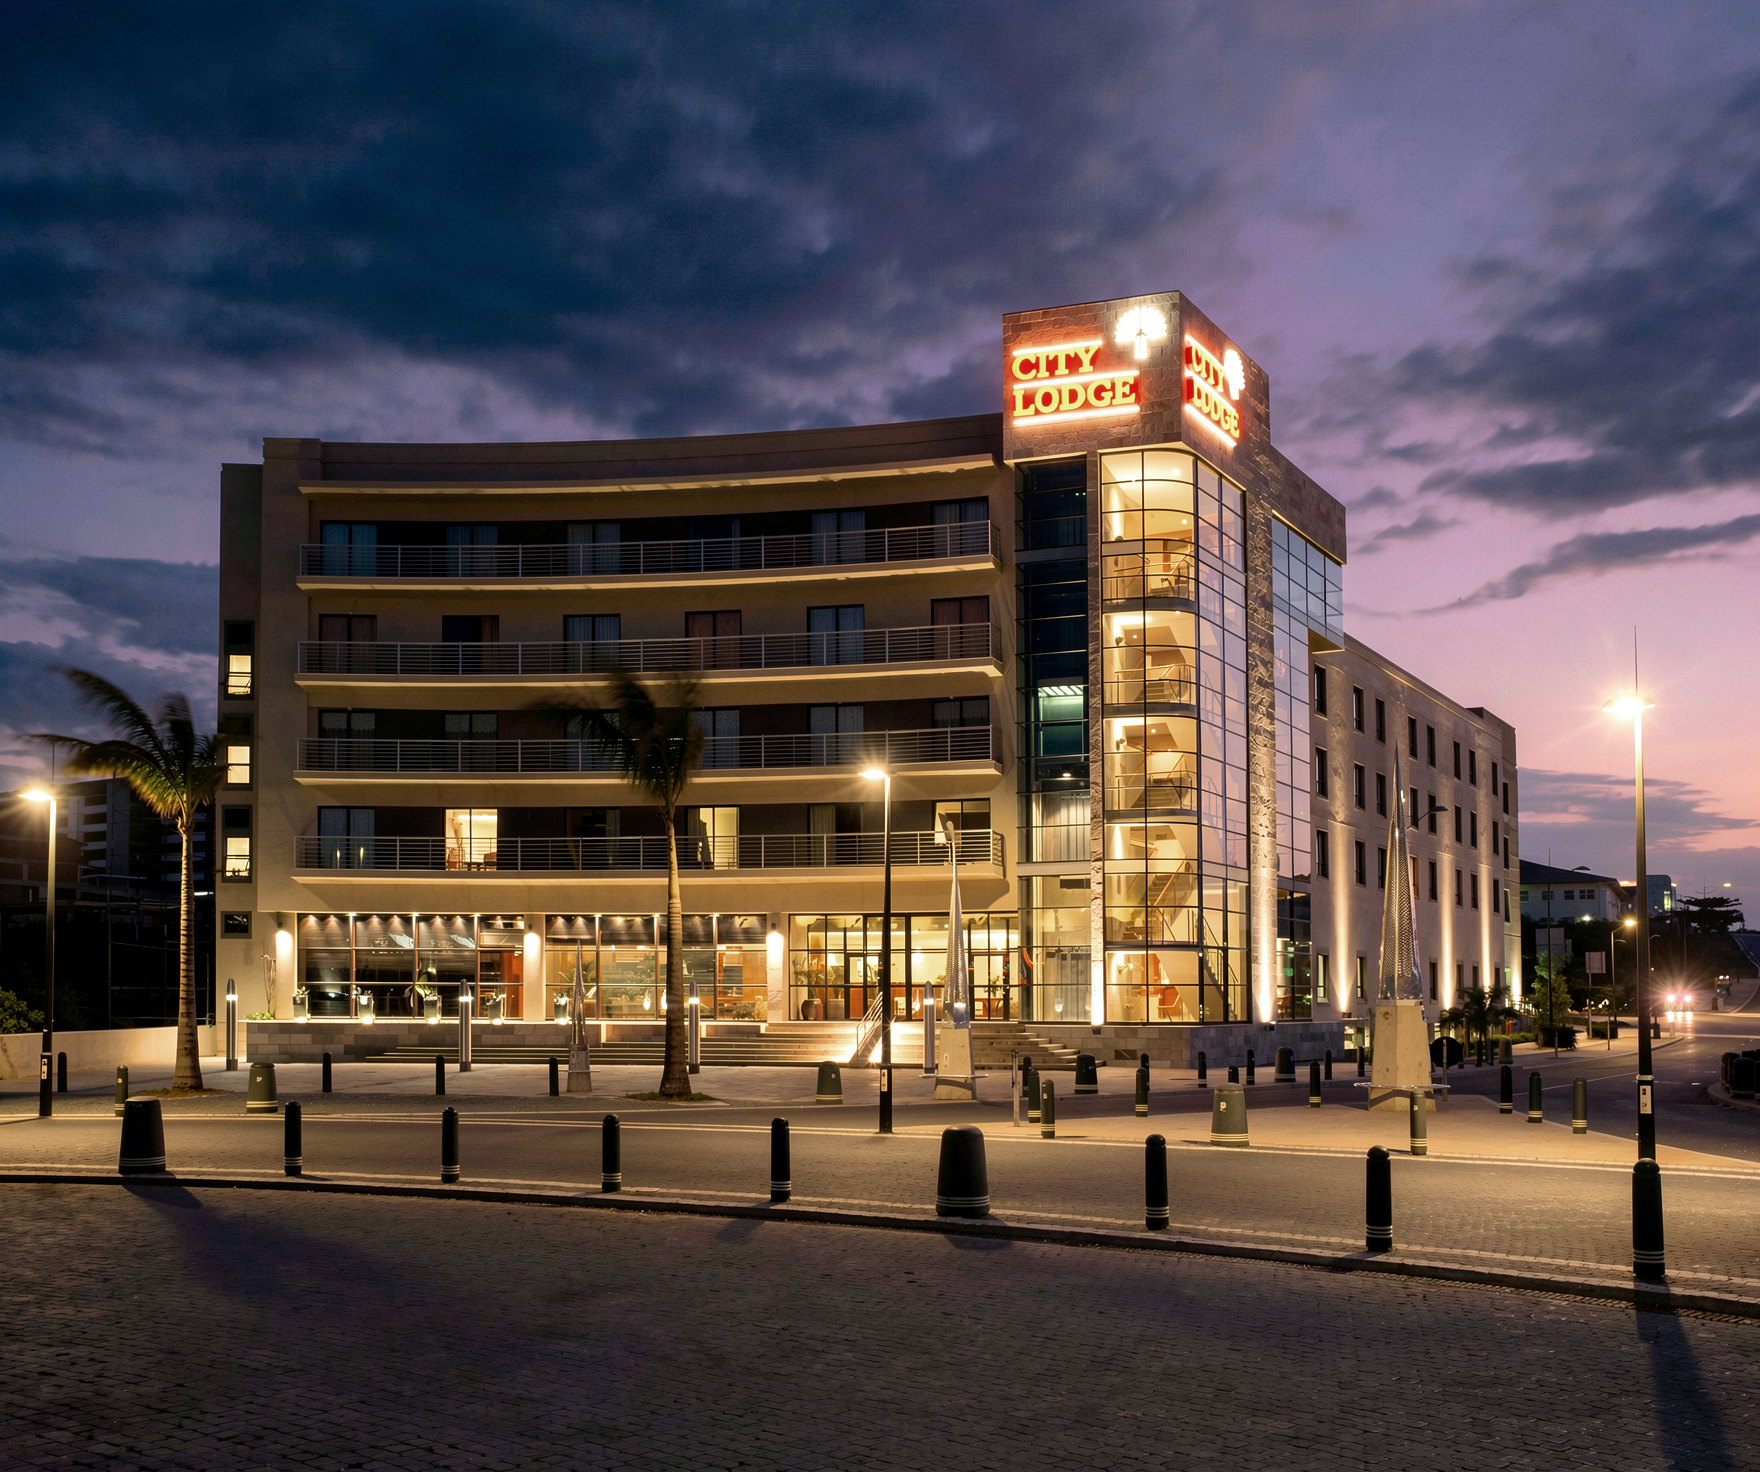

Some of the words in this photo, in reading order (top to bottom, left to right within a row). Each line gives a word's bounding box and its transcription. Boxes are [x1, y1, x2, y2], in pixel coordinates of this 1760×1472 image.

[1011, 344, 1101, 381] CITY
[1191, 344, 1225, 393] CITY
[1012, 375, 1136, 417] LODGE
[1192, 377, 1240, 439] LODGE
